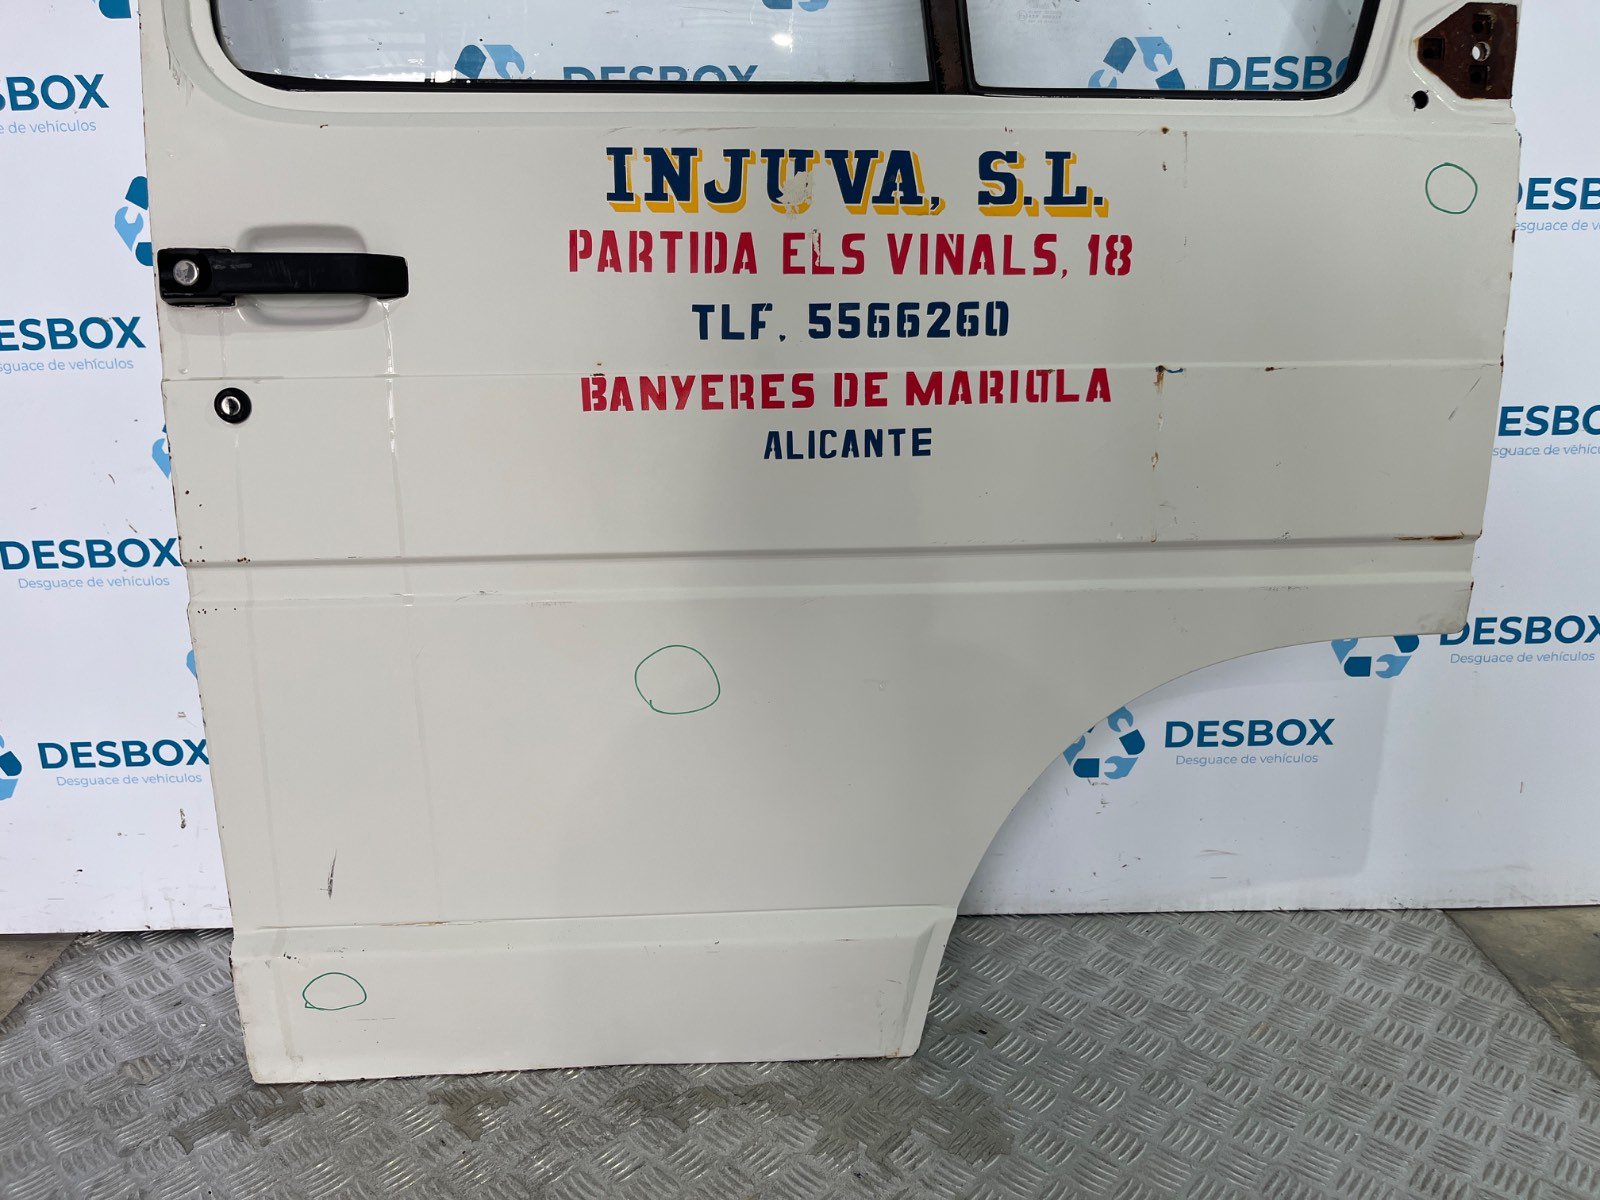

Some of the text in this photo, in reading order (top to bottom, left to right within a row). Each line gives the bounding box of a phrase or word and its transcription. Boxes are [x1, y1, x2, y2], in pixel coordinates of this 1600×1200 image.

[1208, 56, 1349, 91] DESB
[0, 74, 109, 111] BOX
[8, 121, 26, 134] de
[29, 120, 97, 134] vehículos
[978, 150, 1110, 218] S.L.
[1518, 177, 1600, 211] ESB
[1571, 219, 1588, 231] de
[568, 229, 758, 275] PARTIDA
[783, 231, 865, 275] ELS
[1089, 234, 1133, 276] 18
[809, 301, 1009, 339] 5566260
[48, 358, 66, 371] de
[68, 358, 135, 370] vehículos
[580, 368, 1112, 412] BANYERES DE MARIOLA
[763, 427, 933, 459] ALICANTE
[1543, 444, 1561, 456] de
[0, 538, 182, 570] DESBOX
[18, 575, 170, 591] Desguace de vehículos
[1450, 651, 1596, 666] Desguace de vehículos
[1165, 718, 1335, 748] DESBOX
[37, 739, 210, 769] DESBOX
[1175, 752, 1319, 767] Desguace de vehículos
[56, 773, 203, 788] Desguace de vehículos
